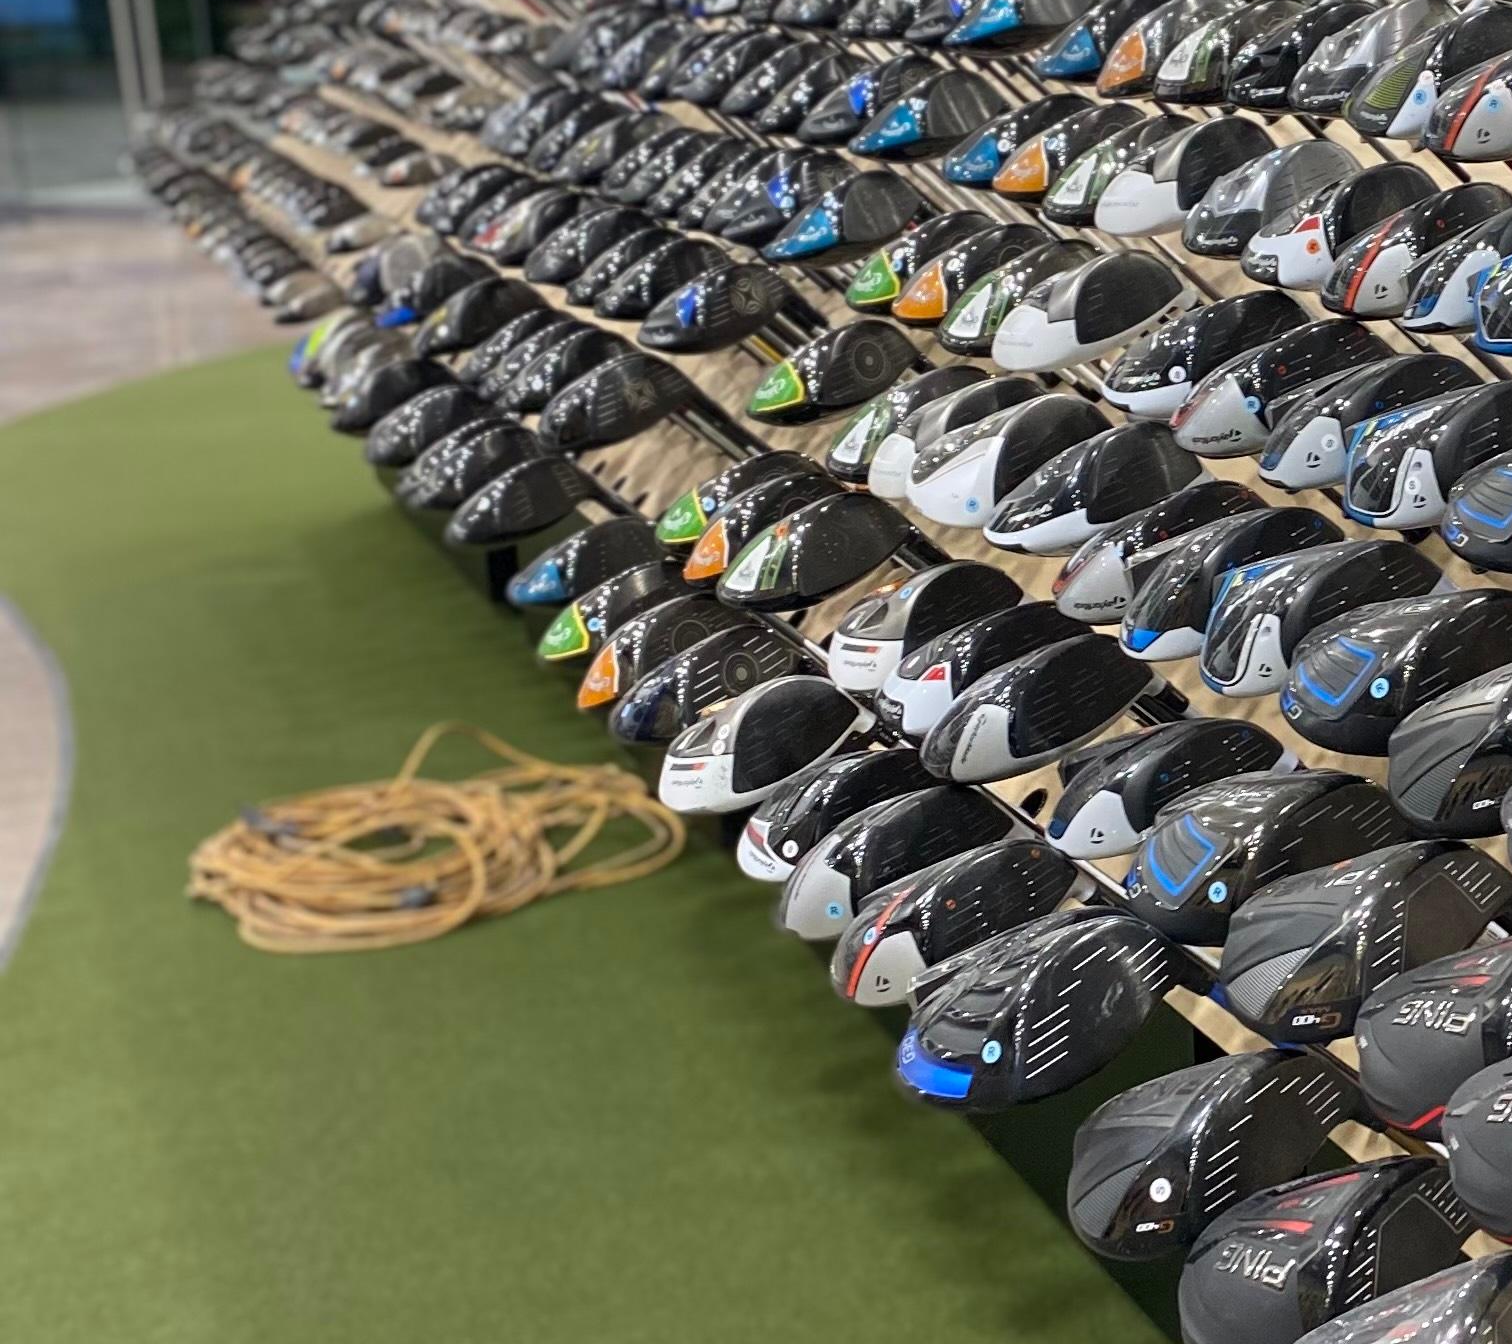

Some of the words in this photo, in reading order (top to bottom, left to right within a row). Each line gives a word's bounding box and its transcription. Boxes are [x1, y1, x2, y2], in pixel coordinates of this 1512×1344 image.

[1291, 1011, 1342, 1029] G400
[1390, 998, 1479, 1037] PING
[1135, 1219, 1174, 1234] G400
[1213, 1240, 1297, 1291] PING
